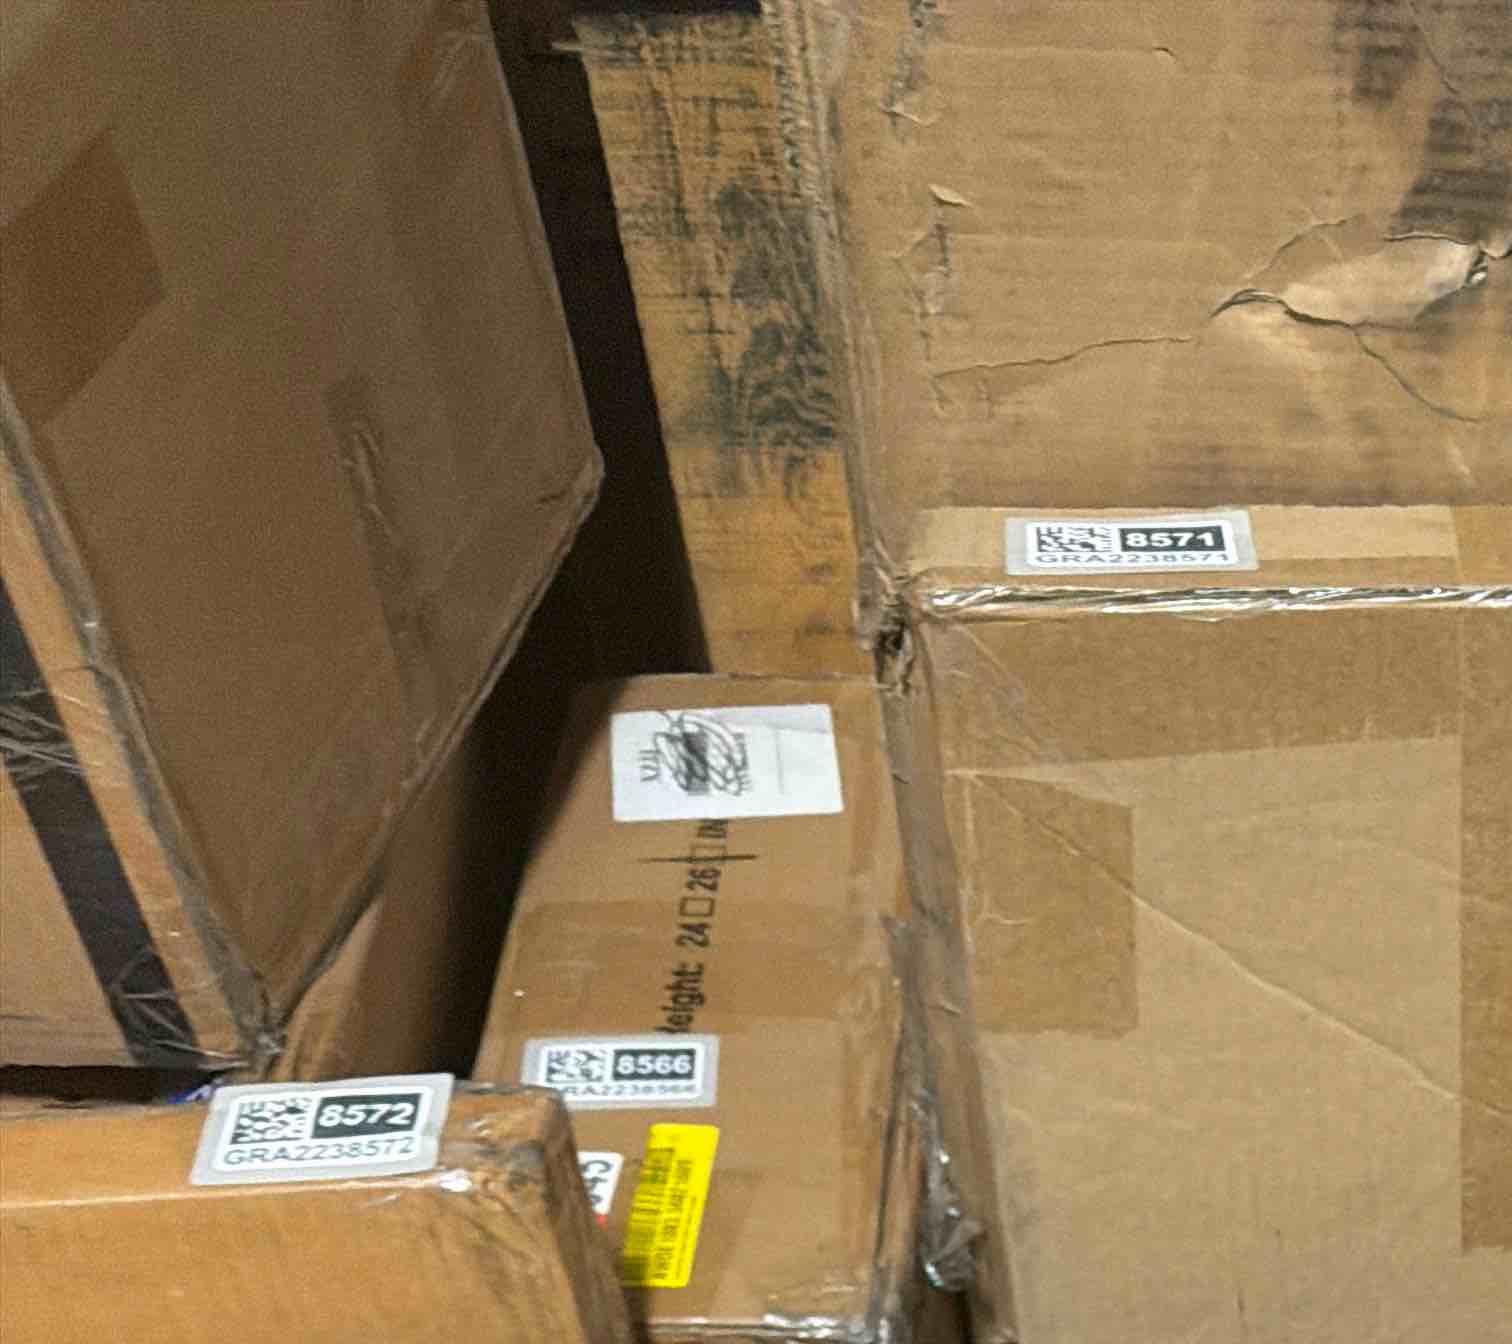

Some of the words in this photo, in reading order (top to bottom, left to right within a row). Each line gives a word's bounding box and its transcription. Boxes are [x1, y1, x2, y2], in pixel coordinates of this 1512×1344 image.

[1126, 532, 1216, 548] 8571
[685, 867, 721, 893] 26
[675, 922, 711, 949] 24
[616, 1053, 693, 1075] 8566
[318, 1102, 414, 1128] 8572
[223, 1136, 417, 1166] GRA2238572
